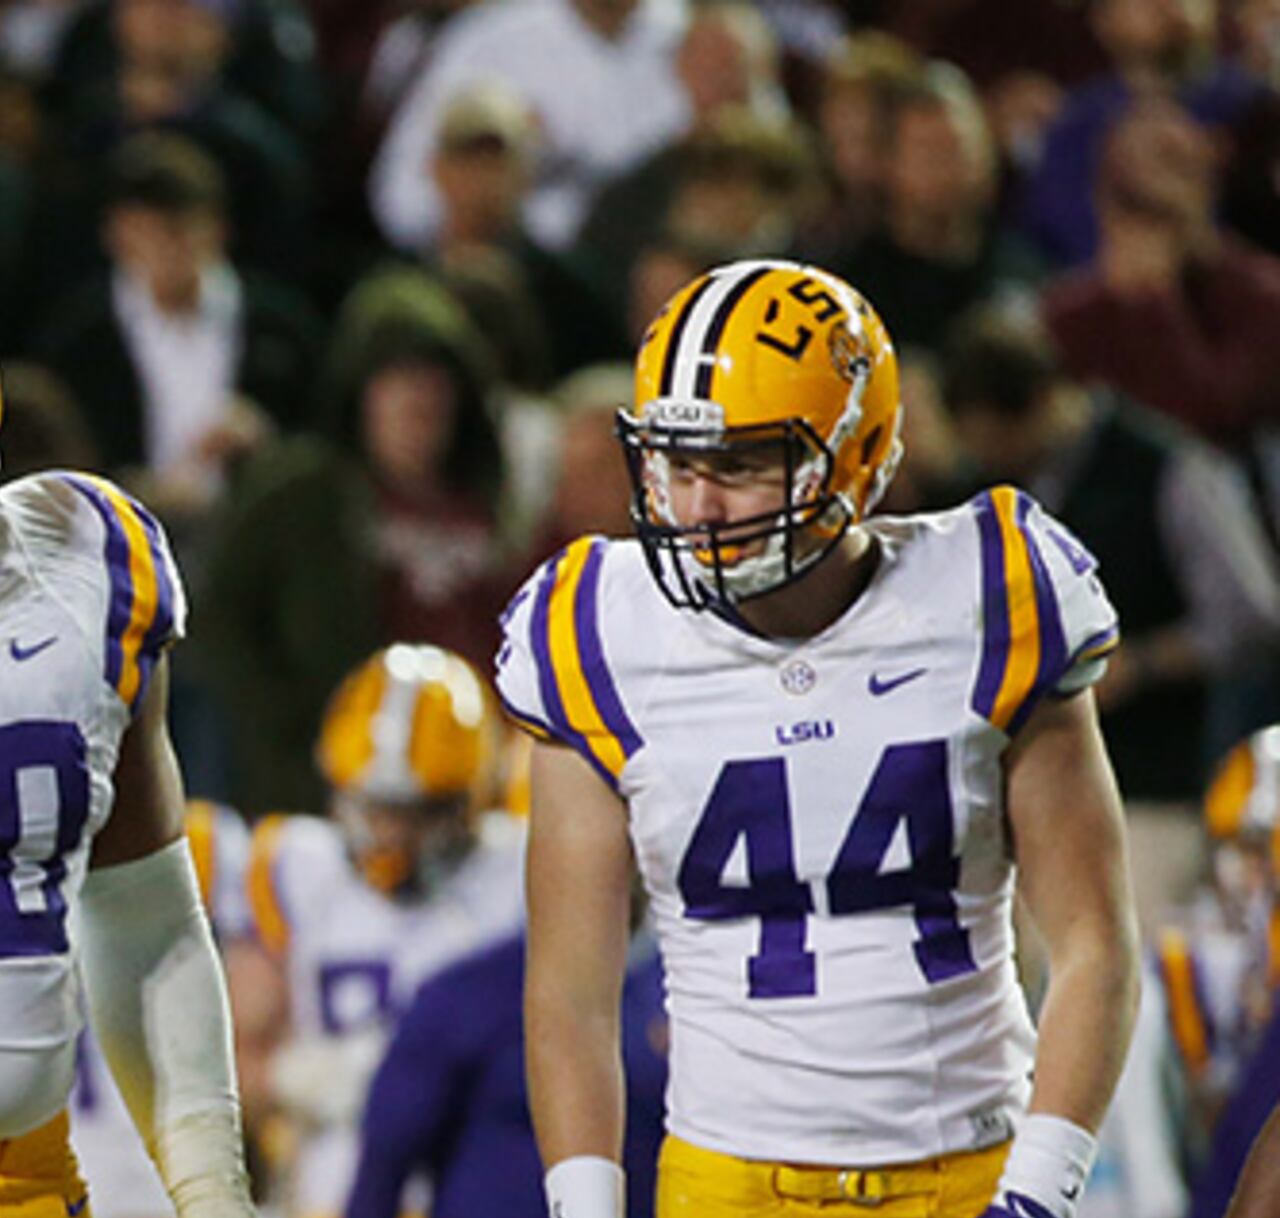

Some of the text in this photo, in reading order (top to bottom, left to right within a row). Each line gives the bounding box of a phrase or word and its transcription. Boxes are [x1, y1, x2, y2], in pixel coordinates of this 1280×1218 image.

[659, 404, 701, 422] LSU
[775, 719, 835, 746] LSU
[676, 739, 978, 999] 44
